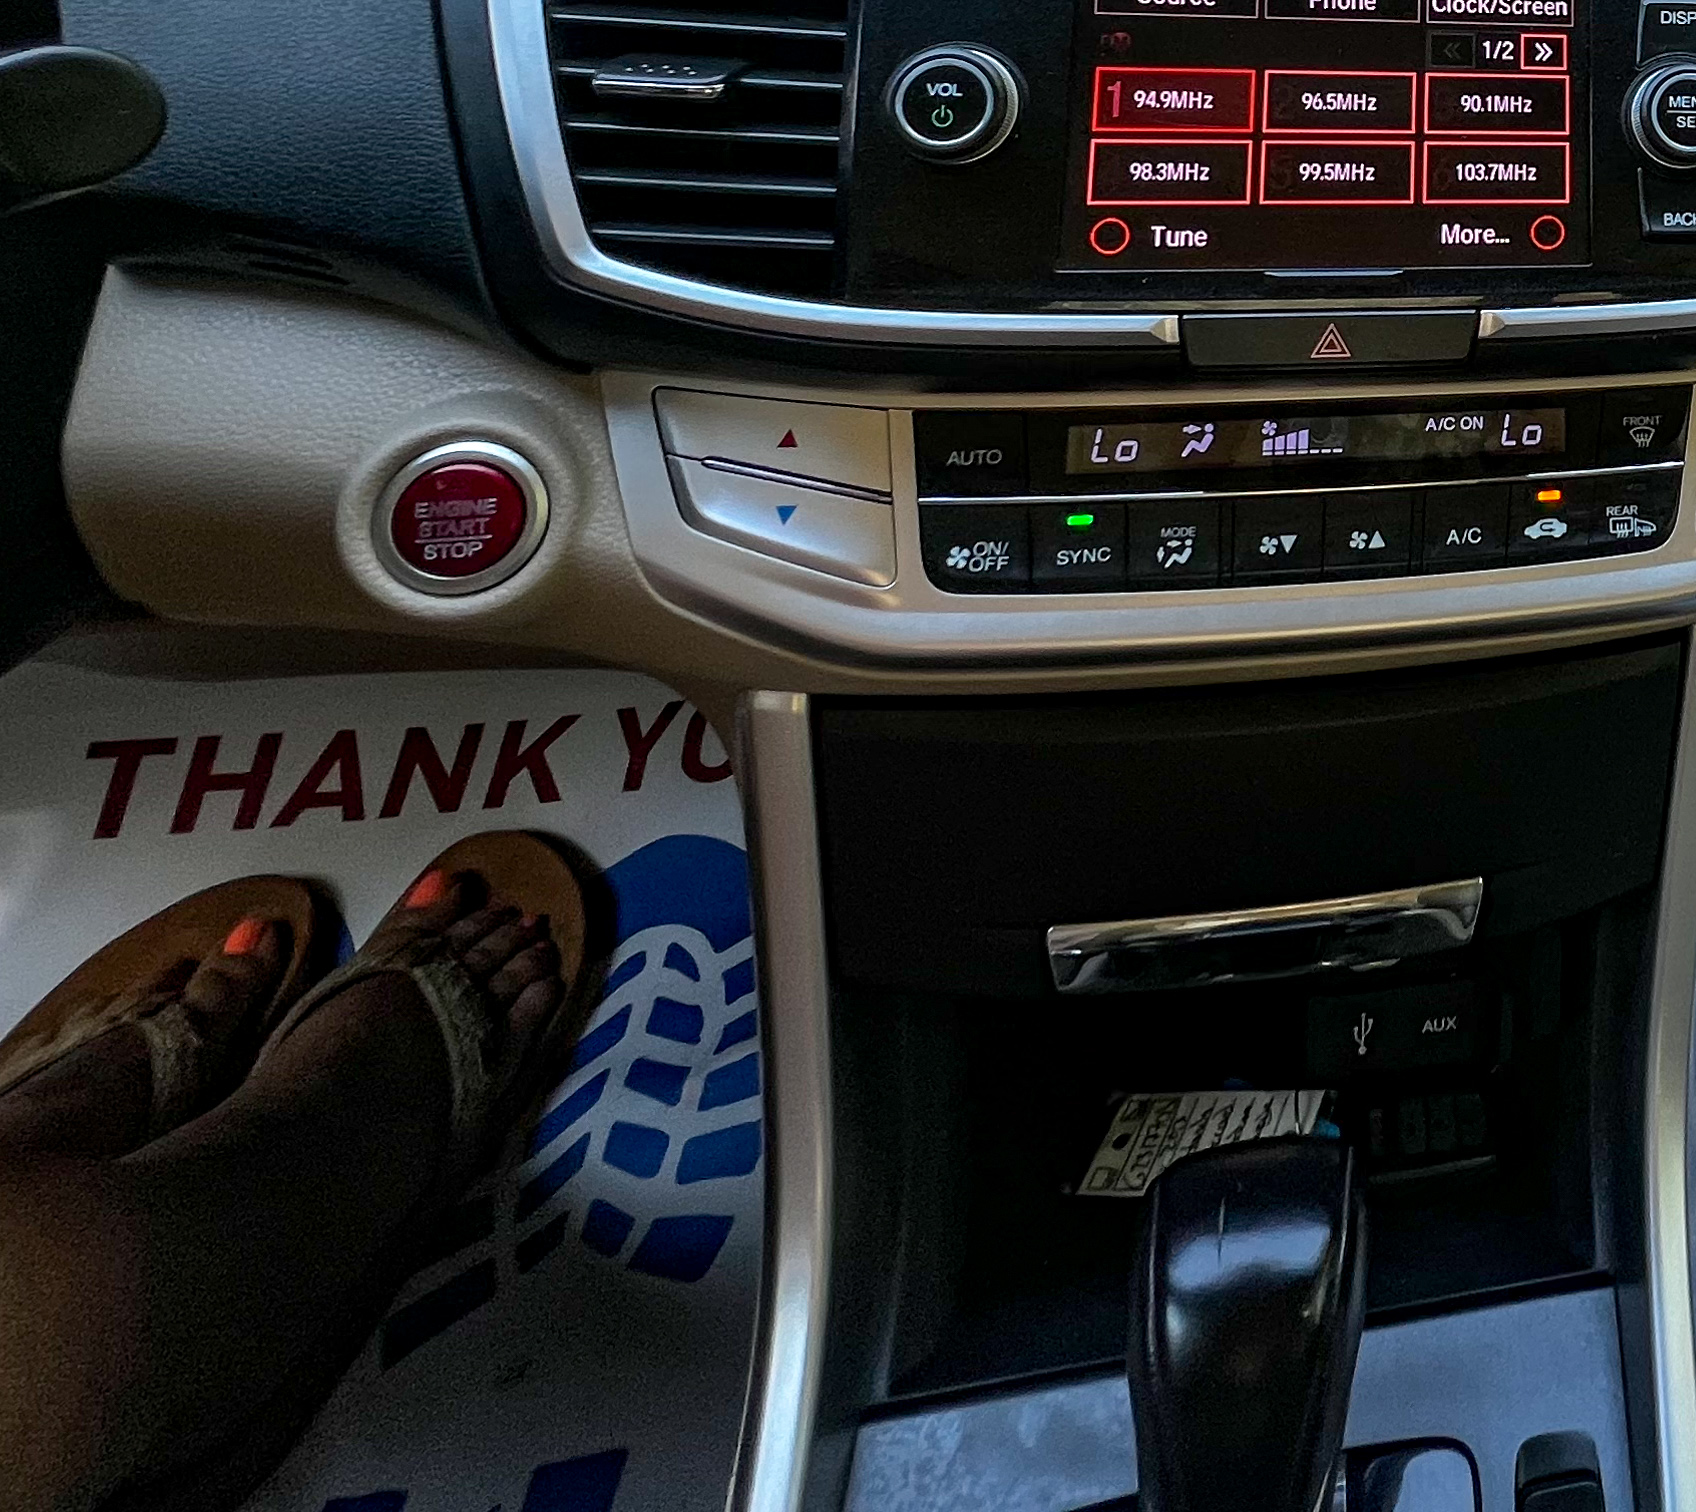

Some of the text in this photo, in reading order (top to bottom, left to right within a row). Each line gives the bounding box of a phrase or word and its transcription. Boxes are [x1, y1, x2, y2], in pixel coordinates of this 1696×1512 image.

[1482, 40, 1514, 62] 1/2
[926, 82, 963, 97] VOL
[1133, 89, 1214, 109] 94.9MHz
[1302, 92, 1378, 113] 96.5MHz
[1460, 93, 1532, 115] 90.1MHz
[1129, 162, 1211, 182] 98.3MHz
[1299, 163, 1376, 182] 99.5MHz
[1455, 163, 1538, 182] 103.7MHz
[1151, 225, 1208, 248] Tune
[1440, 225, 1511, 246] More...
[1425, 415, 1484, 432] A/C ON
[1501, 413, 1543, 447] Lo
[1623, 415, 1662, 426] FRONT
[1091, 428, 1139, 464] Lo
[946, 449, 1003, 467] AUTO
[414, 497, 498, 519] ENGINE
[1606, 505, 1639, 517] REAR
[418, 517, 491, 538] START
[1160, 526, 1196, 539] MODE
[1446, 527, 1482, 546] A/C
[424, 541, 484, 561] STOP
[972, 541, 1010, 556] ON/
[1056, 547, 1112, 566] SYNC
[968, 555, 1010, 572] OFF
[86, 699, 734, 841] THANK YO
[1422, 1016, 1457, 1034] AUX
